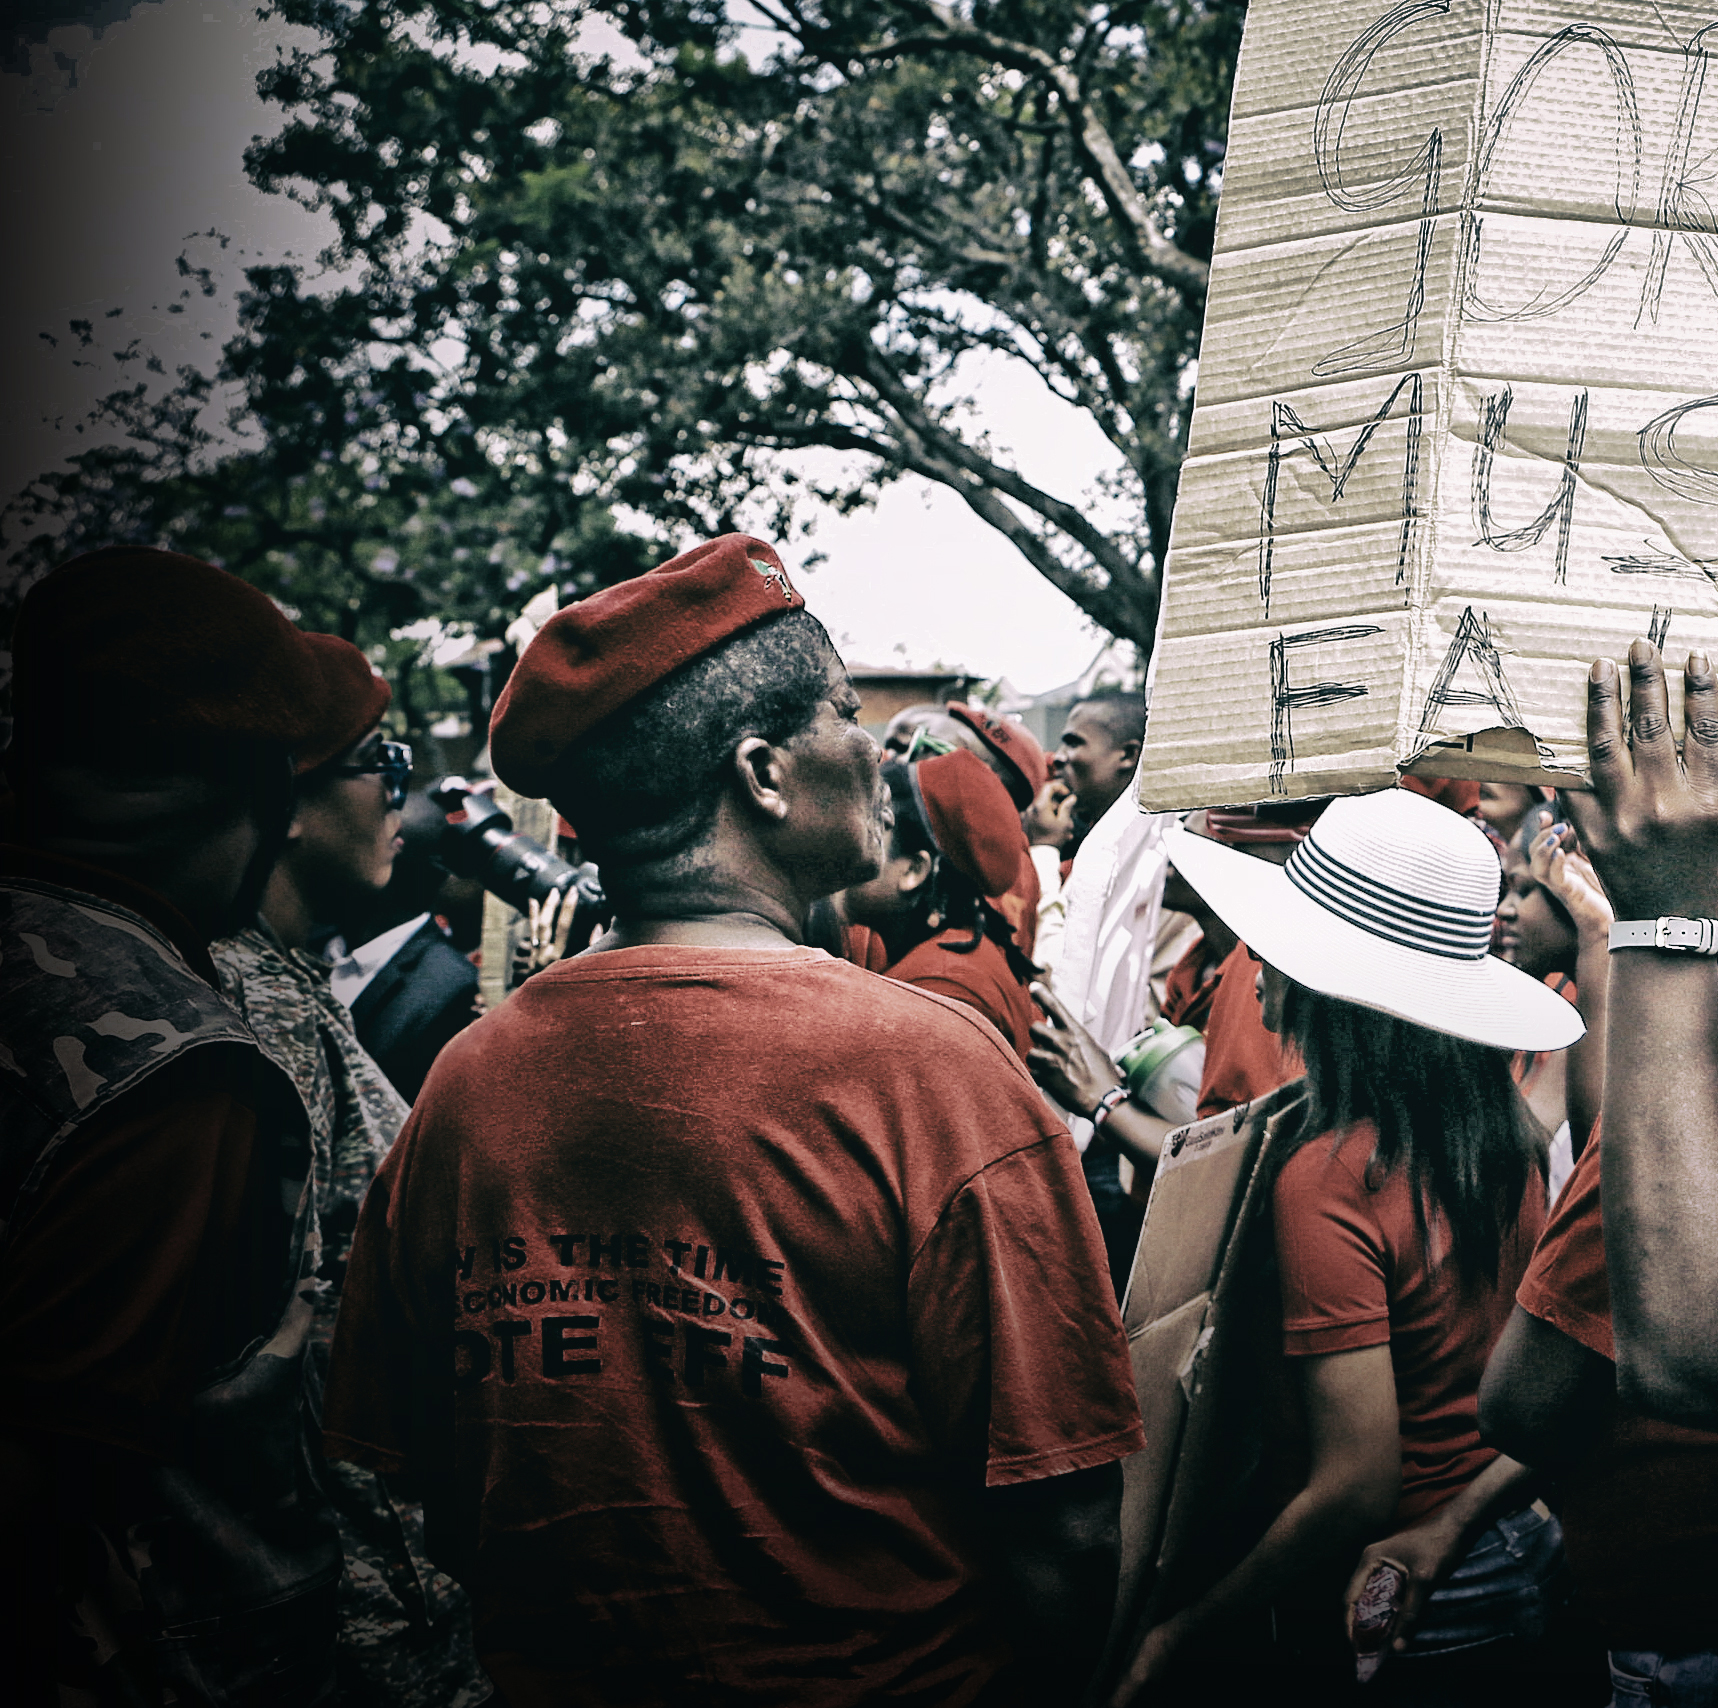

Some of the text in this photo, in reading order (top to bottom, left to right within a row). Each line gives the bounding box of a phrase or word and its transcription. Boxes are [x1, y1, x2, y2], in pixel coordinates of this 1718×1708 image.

[491, 1235, 527, 1270] IS
[550, 1234, 649, 1268] THE
[664, 1241, 785, 1296] TIME
[454, 1279, 620, 1316] CONOMIC
[454, 1316, 789, 1398] OTE EFF
